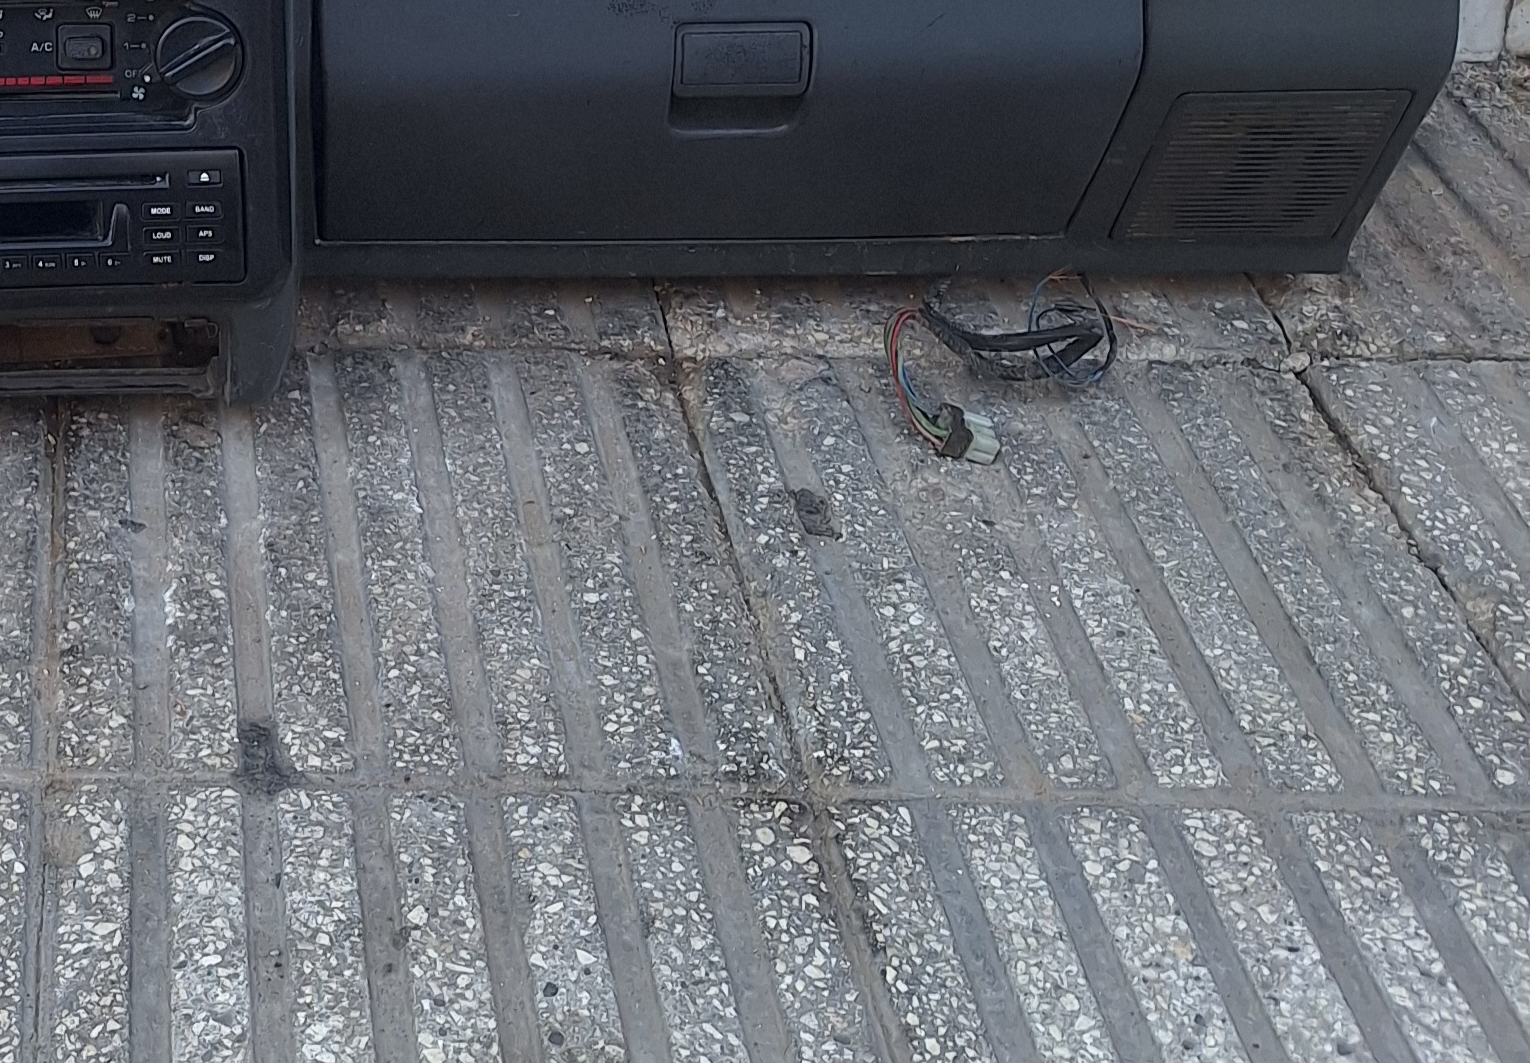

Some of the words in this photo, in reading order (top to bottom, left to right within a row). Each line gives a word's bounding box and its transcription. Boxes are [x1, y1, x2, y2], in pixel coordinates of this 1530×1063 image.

[126, 13, 137, 23] 2
[30, 42, 53, 53] A/C
[150, 206, 172, 215] MODE
[194, 205, 215, 214] BAND
[152, 231, 172, 239] LOUD
[152, 256, 172, 264] MUTE
